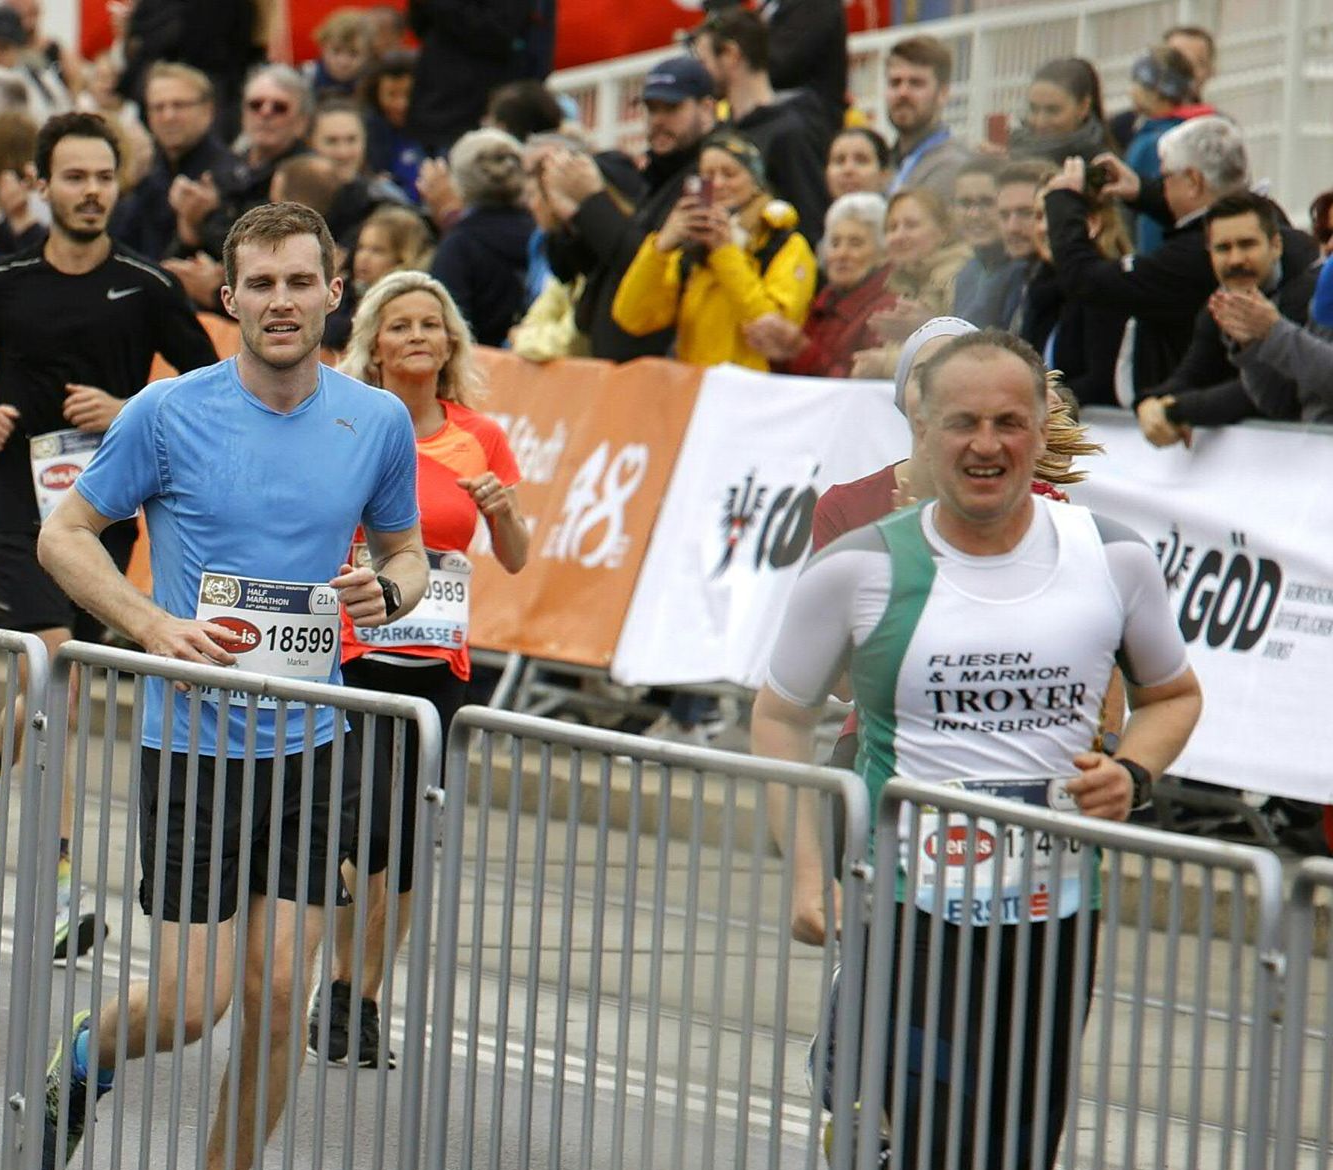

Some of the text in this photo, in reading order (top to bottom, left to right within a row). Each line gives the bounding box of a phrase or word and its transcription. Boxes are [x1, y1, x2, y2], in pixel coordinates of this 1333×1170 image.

[247, 588, 268, 597] HALF
[1178, 530, 1283, 652] GÖD
[246, 595, 290, 606] MARATHON
[266, 625, 334, 654] 18599
[360, 626, 450, 642] SPARKASSE
[928, 652, 1032, 667] FLIESEN
[929, 666, 1070, 683] & MARMOR
[925, 682, 1086, 714] TROYER
[933, 713, 1085, 733] INNSBRUCK
